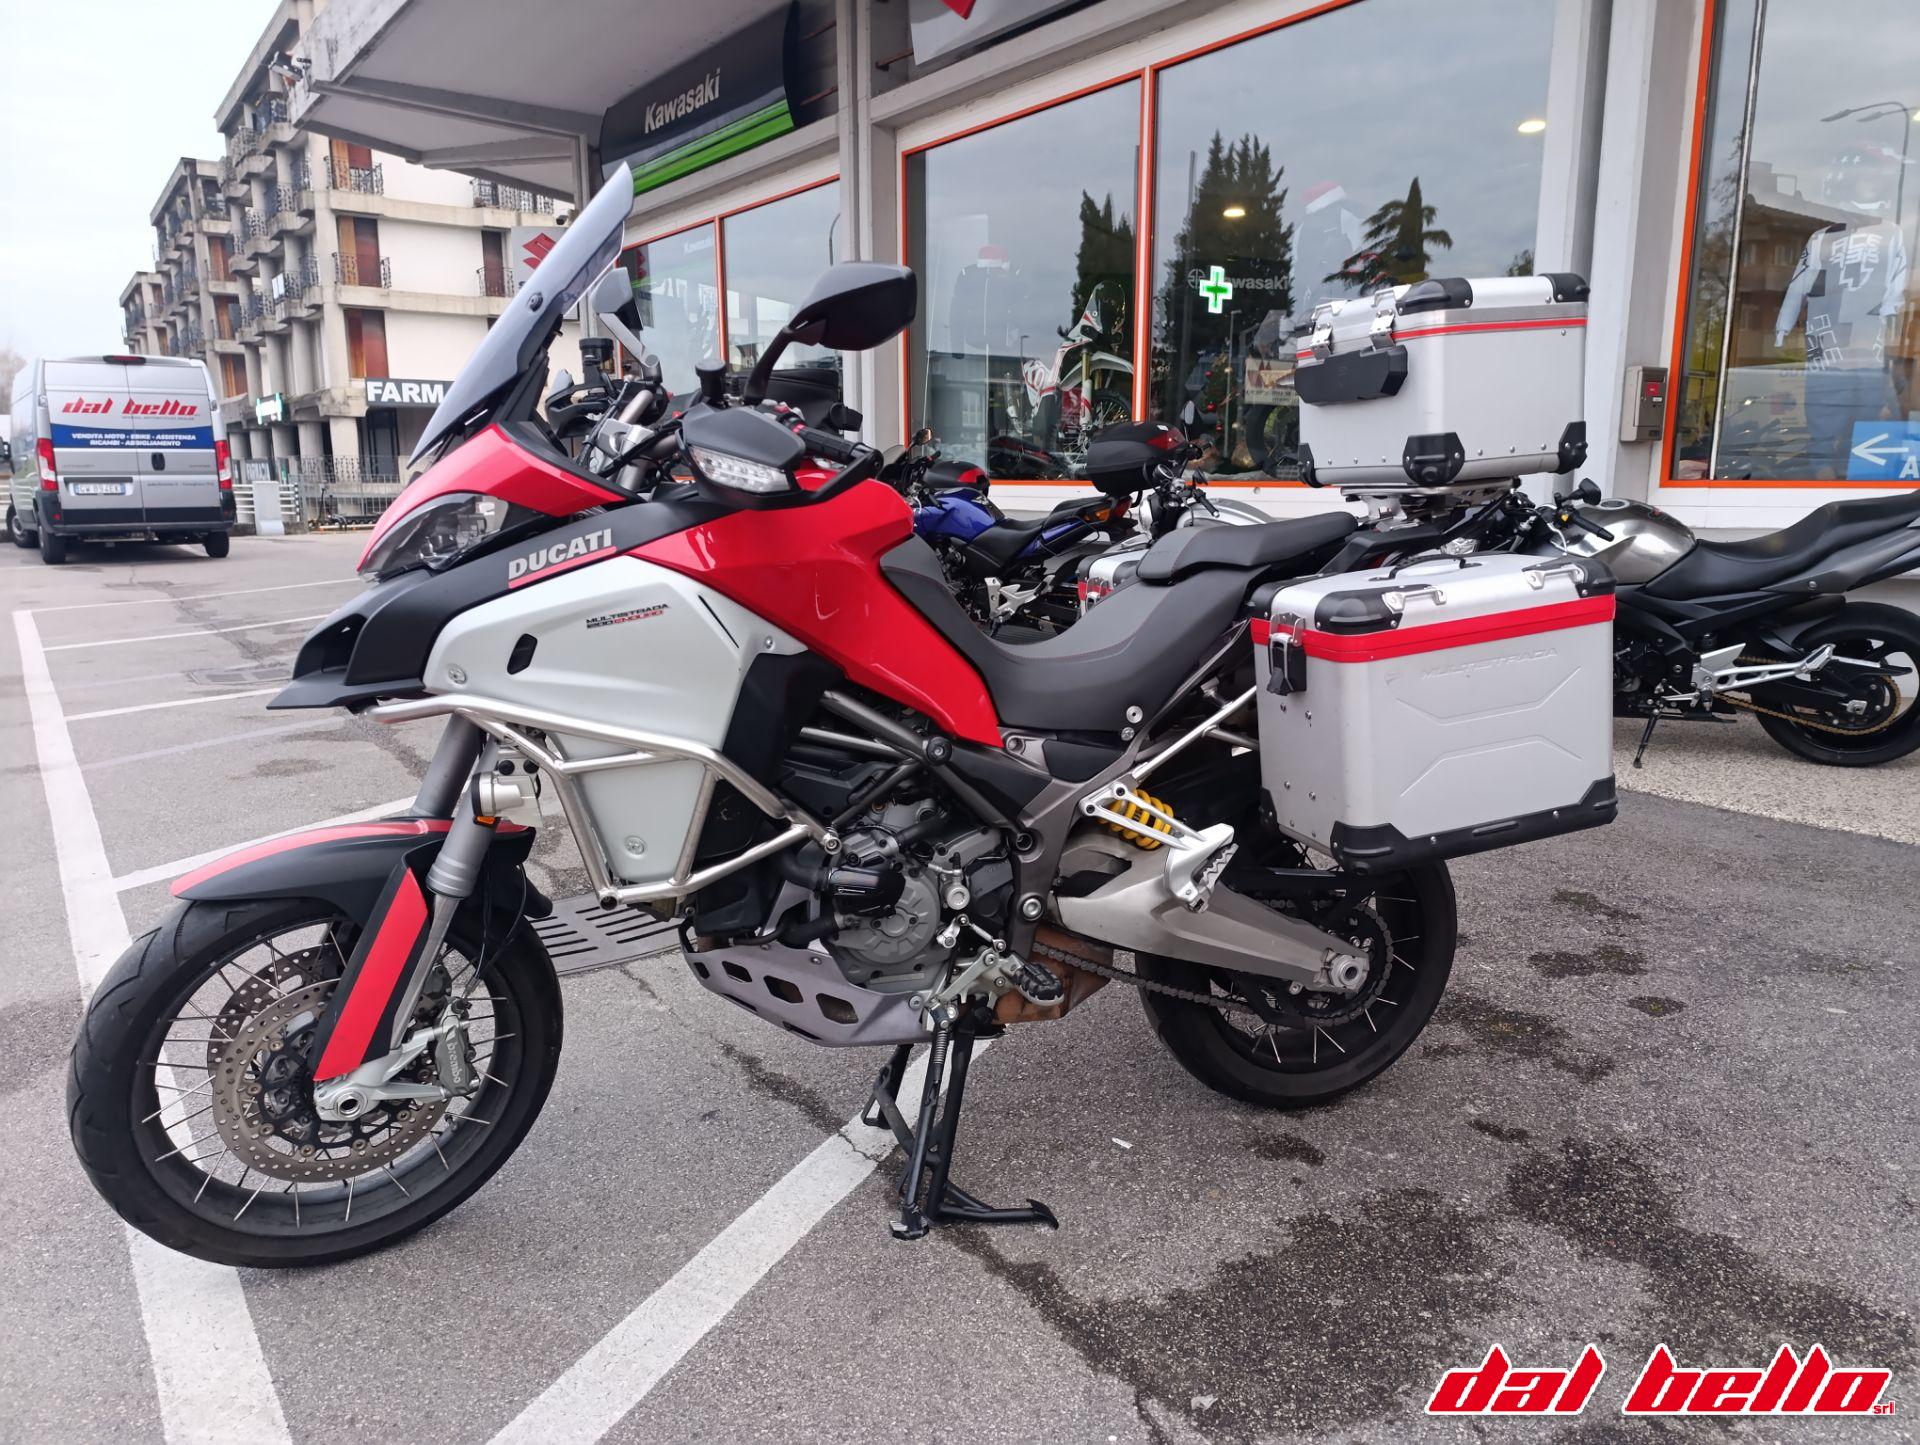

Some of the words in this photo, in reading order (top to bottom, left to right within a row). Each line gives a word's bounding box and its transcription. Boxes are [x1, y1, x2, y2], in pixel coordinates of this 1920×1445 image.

[644, 67, 721, 134] Kawasaki
[1224, 275, 1289, 291] wasaki
[366, 381, 444, 404] FARM
[62, 397, 114, 414] dal
[121, 398, 198, 416] bello
[508, 528, 612, 580] DUCATI
[585, 603, 669, 624] MULTISTRADA
[446, 1041, 463, 1084] brembo
